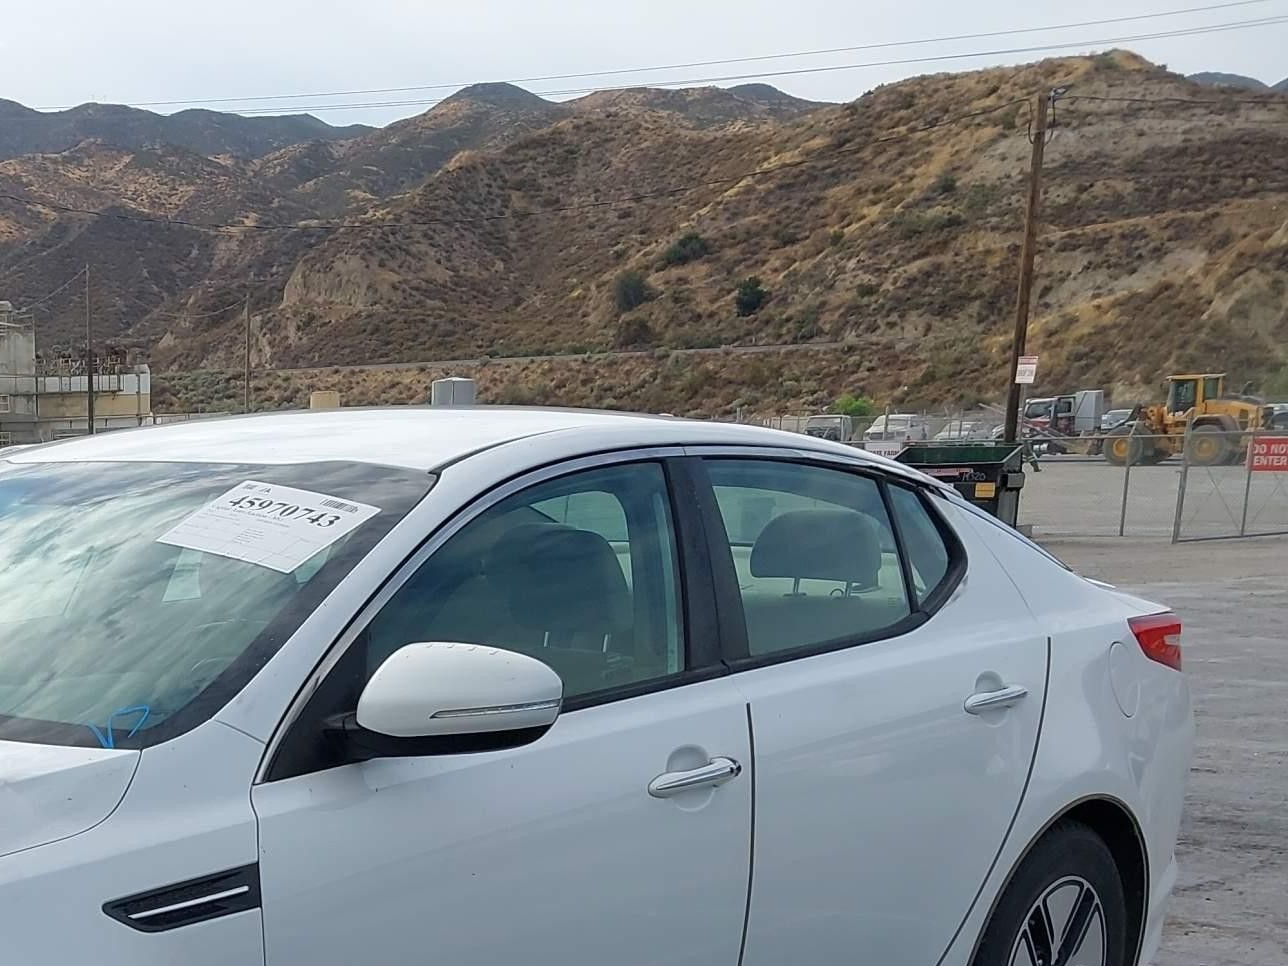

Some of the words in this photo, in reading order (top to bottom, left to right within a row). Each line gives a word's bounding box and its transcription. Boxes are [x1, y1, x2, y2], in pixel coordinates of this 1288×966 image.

[1271, 443, 1288, 455] NO
[1253, 455, 1287, 466] ENTER
[229, 495, 341, 528] 45970743
